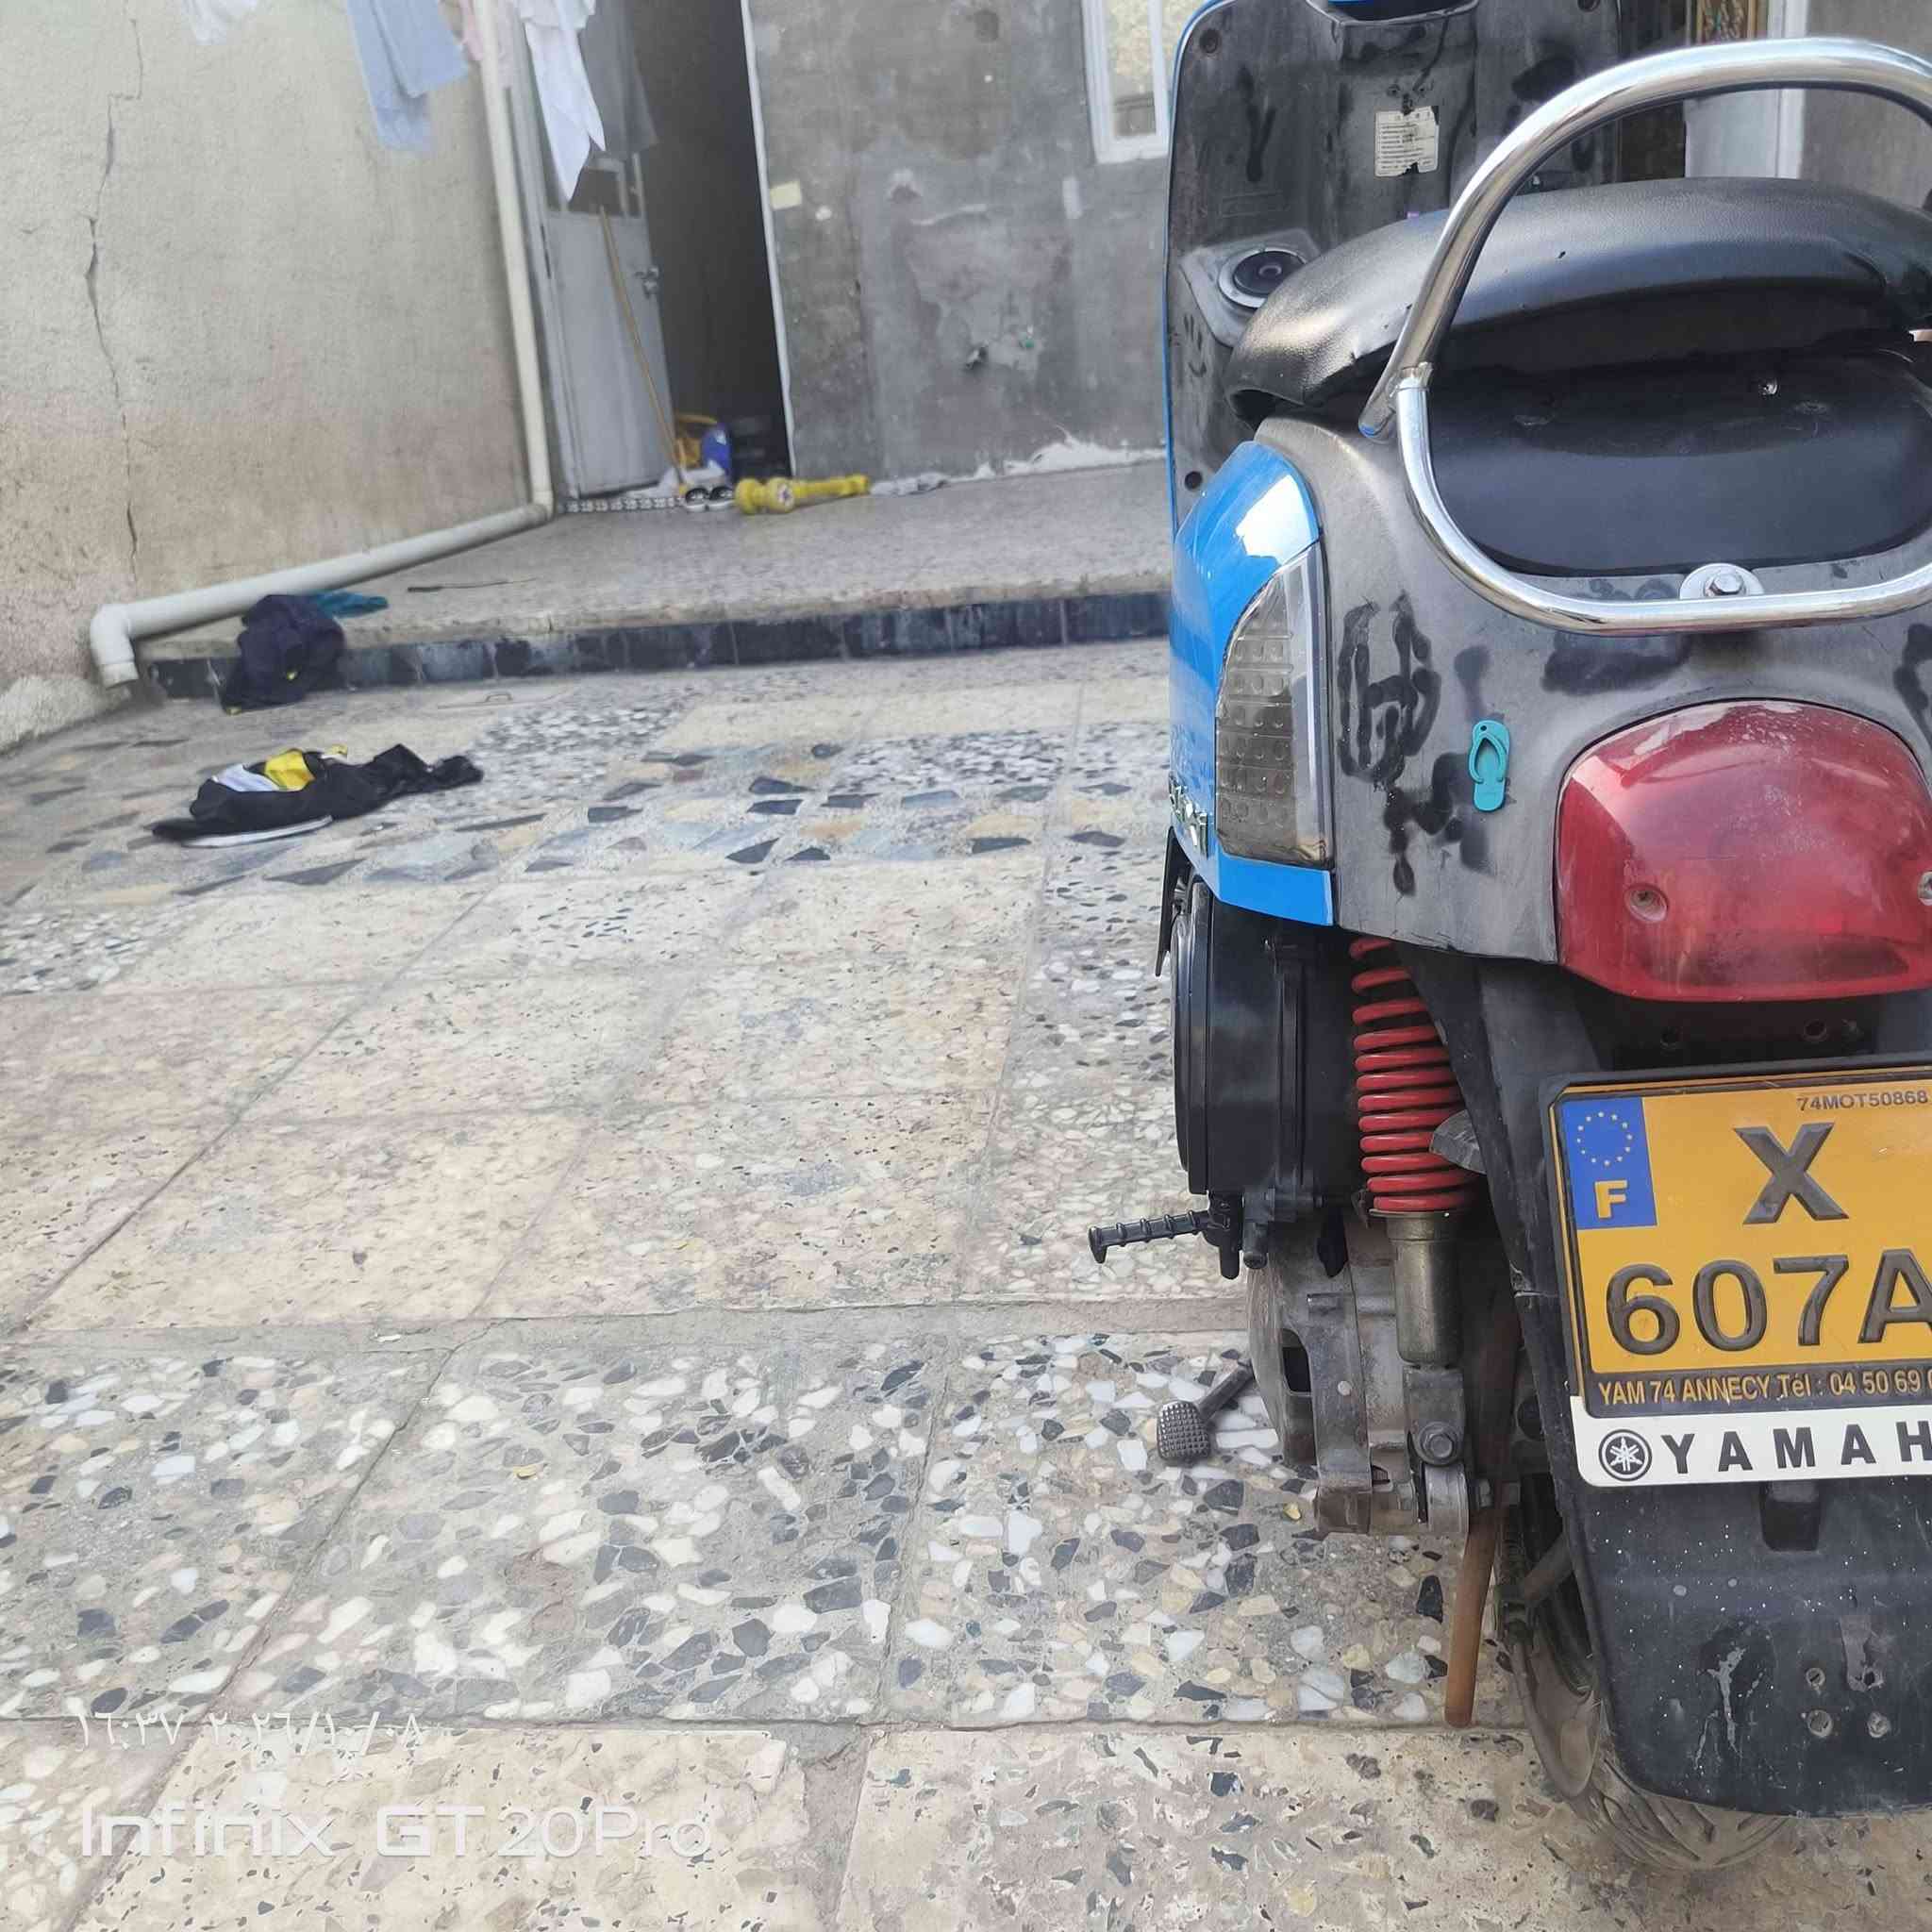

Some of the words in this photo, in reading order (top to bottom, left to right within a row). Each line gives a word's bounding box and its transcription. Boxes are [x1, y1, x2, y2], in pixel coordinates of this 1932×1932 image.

[1796, 1090, 1929, 1111] 74MOT50868
[1733, 1123, 1850, 1225] X
[1594, 1180, 1628, 1220] F
[1606, 1248, 1932, 1356] 607A
[1598, 1380, 1645, 1406] YAM
[1650, 1378, 1675, 1404] 74
[1682, 1374, 1770, 1404] ANNECY
[1777, 1373, 1811, 1398] Tél
[1829, 1372, 1856, 1396] 04
[1862, 1370, 1889, 1395] 50
[1894, 1369, 1921, 1393] 69
[1660, 1421, 1932, 1474] YAMAH
